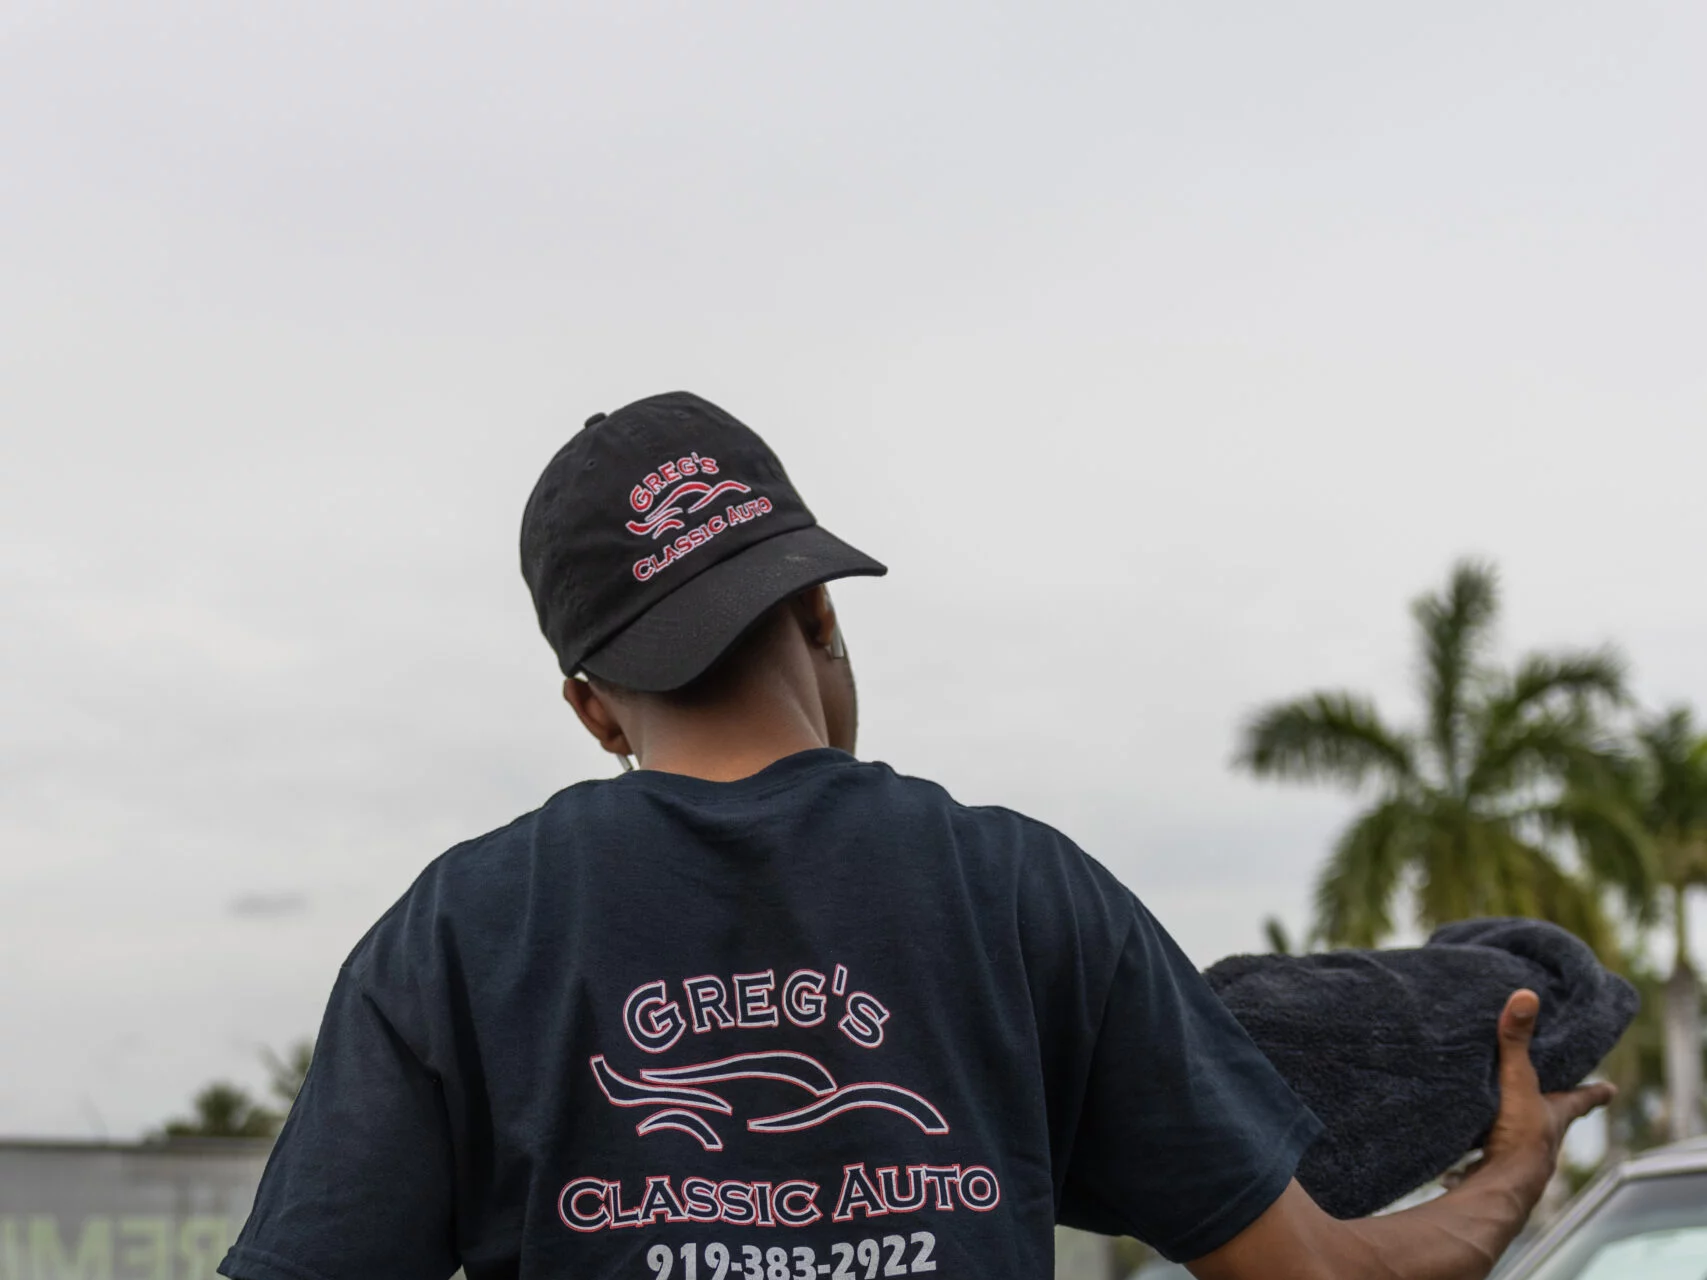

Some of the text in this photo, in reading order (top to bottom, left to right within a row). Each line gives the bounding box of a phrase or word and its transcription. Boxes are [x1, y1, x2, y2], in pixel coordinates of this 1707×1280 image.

[630, 452, 719, 513] GREG'S
[633, 496, 773, 582] CLASSIC AUTO
[623, 963, 889, 1054] GREG'S
[558, 1162, 1001, 1232] CLASSIC AUTO
